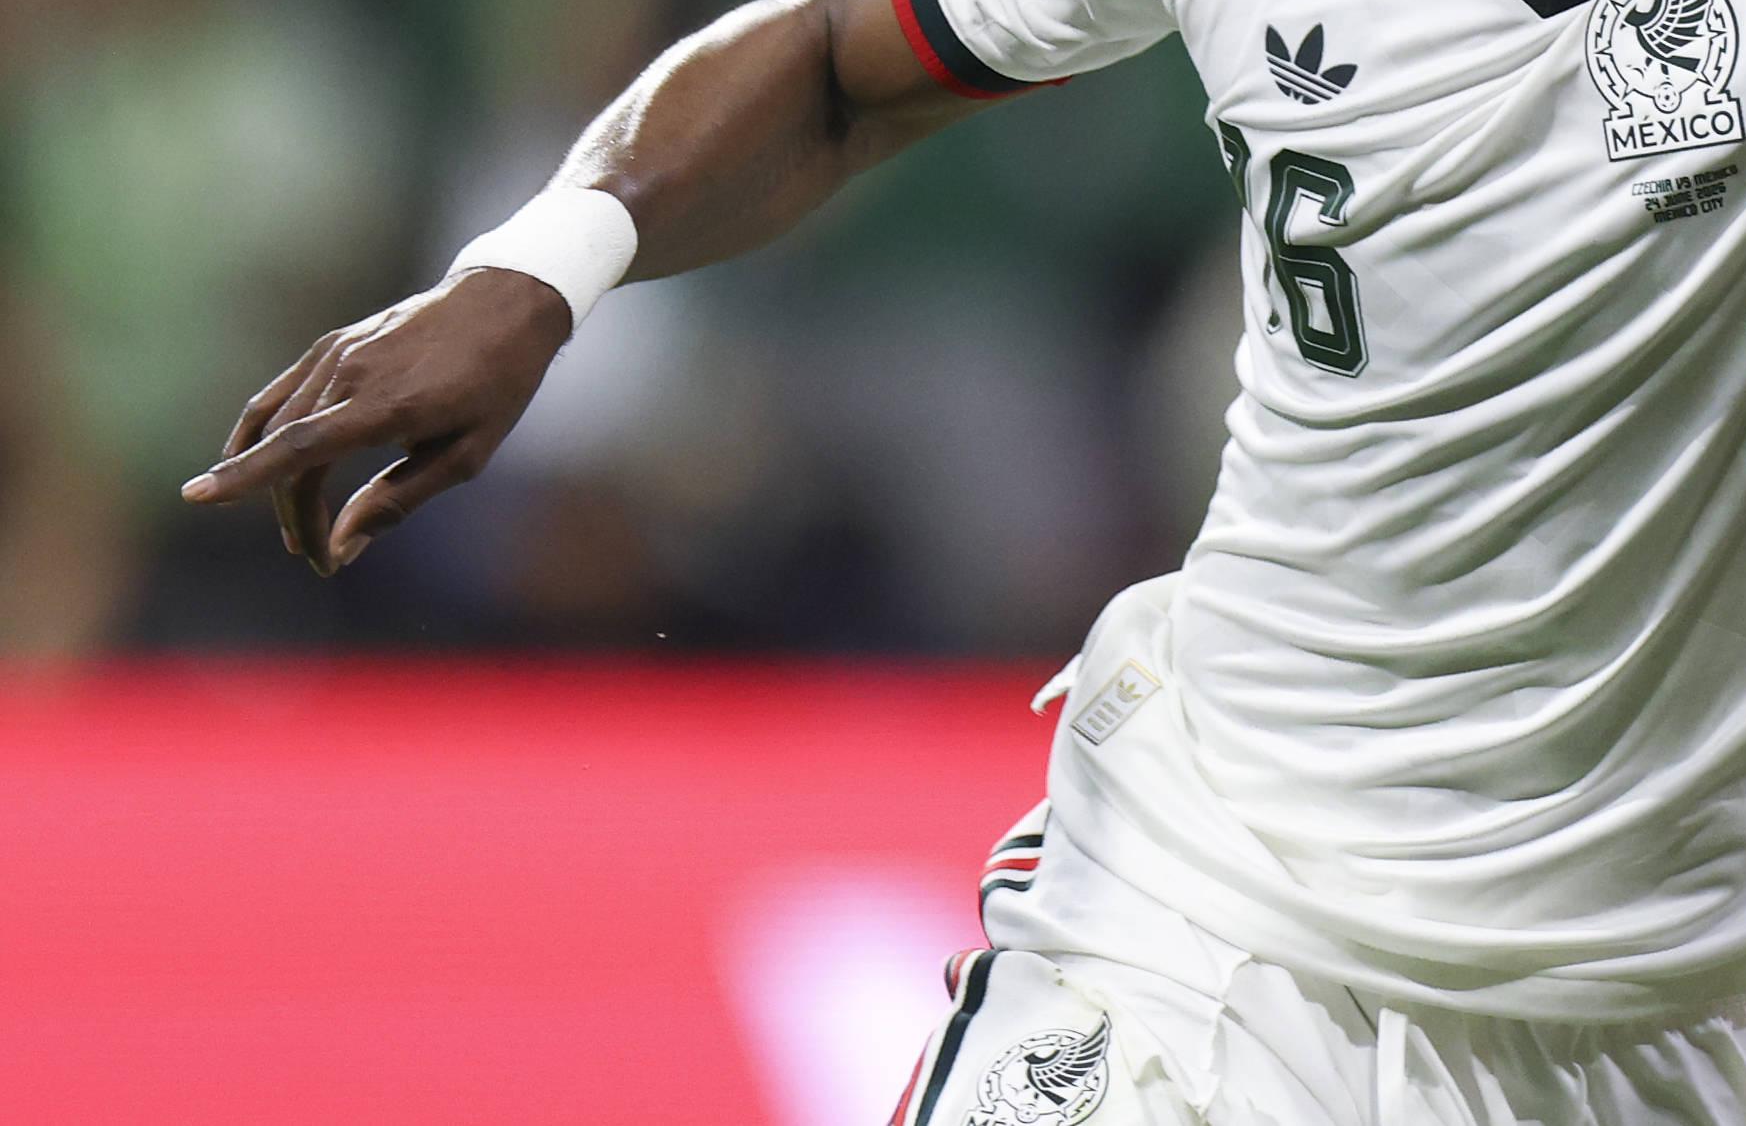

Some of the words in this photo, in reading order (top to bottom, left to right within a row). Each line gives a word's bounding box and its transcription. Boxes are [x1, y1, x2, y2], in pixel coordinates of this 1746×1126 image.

[1610, 109, 1735, 153] MÉXICO
[1675, 176, 1692, 190] VS
[1644, 197, 1661, 211] 24
[1700, 197, 1724, 214] CITY
